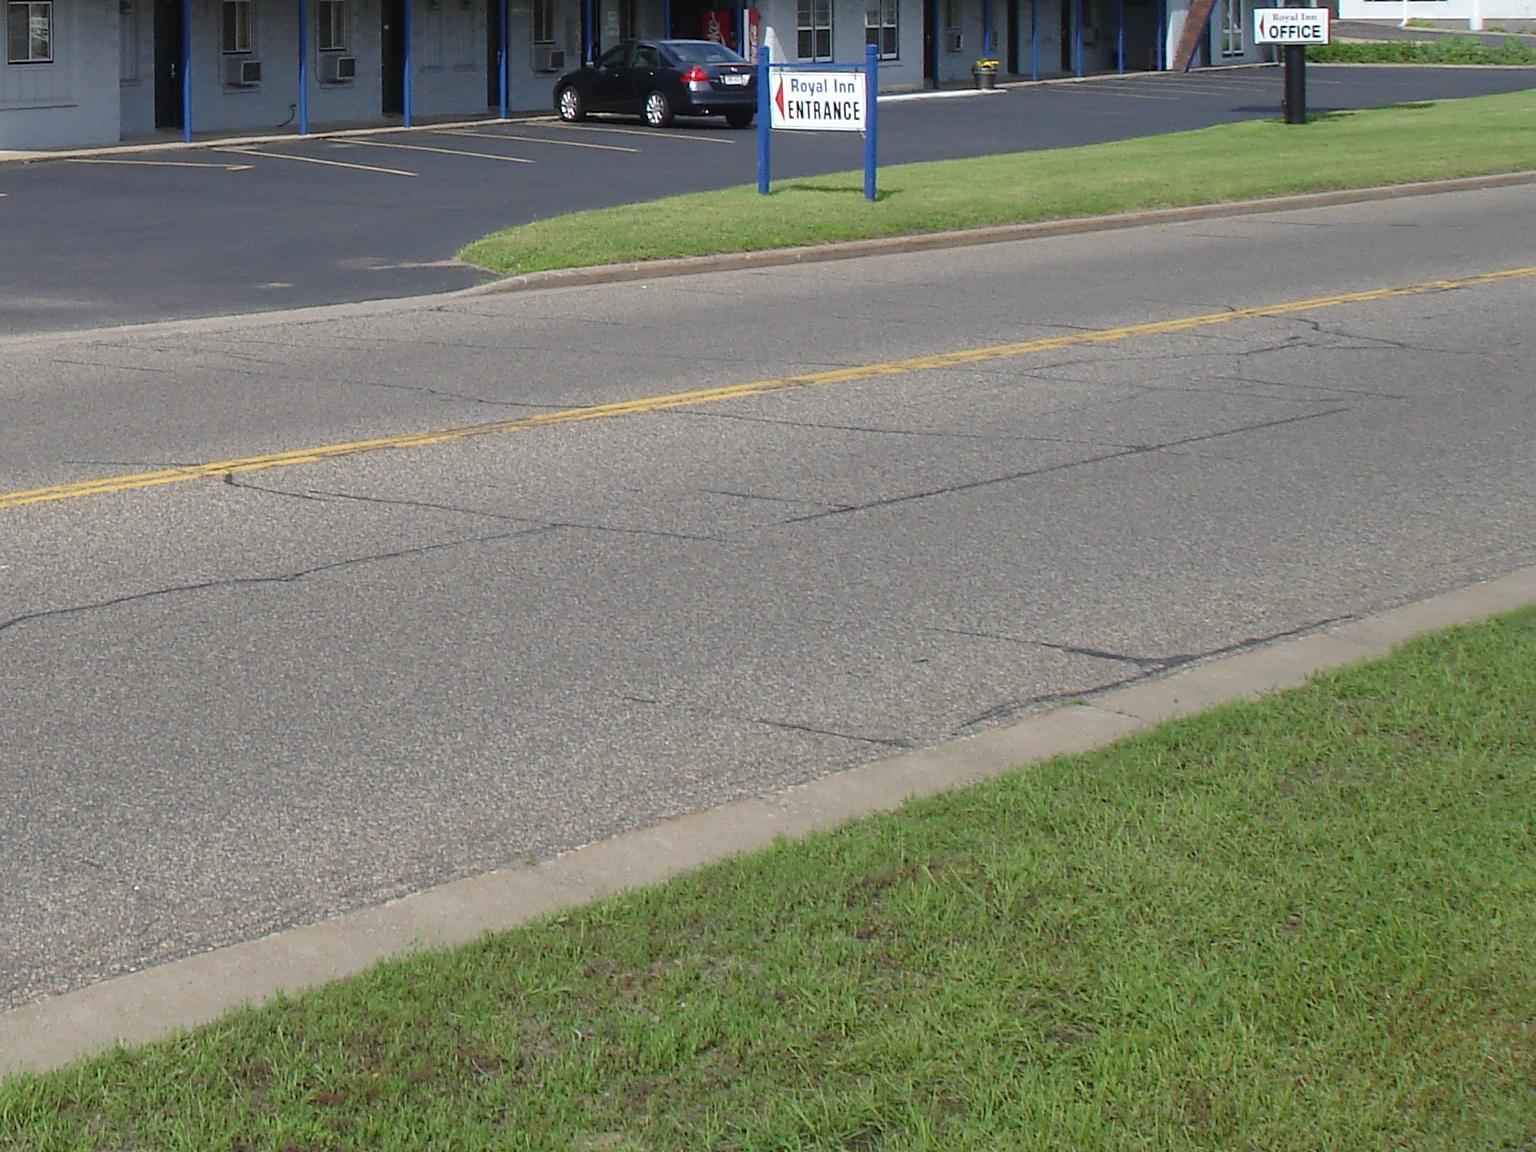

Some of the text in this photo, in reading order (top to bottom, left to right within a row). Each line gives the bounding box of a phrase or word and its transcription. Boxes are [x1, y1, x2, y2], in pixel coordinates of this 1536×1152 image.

[1272, 13, 1318, 24] Royal Inn
[1269, 25, 1321, 39] OFFICE
[790, 78, 855, 96] Royal Inn
[788, 100, 860, 121] ENTRANCE
